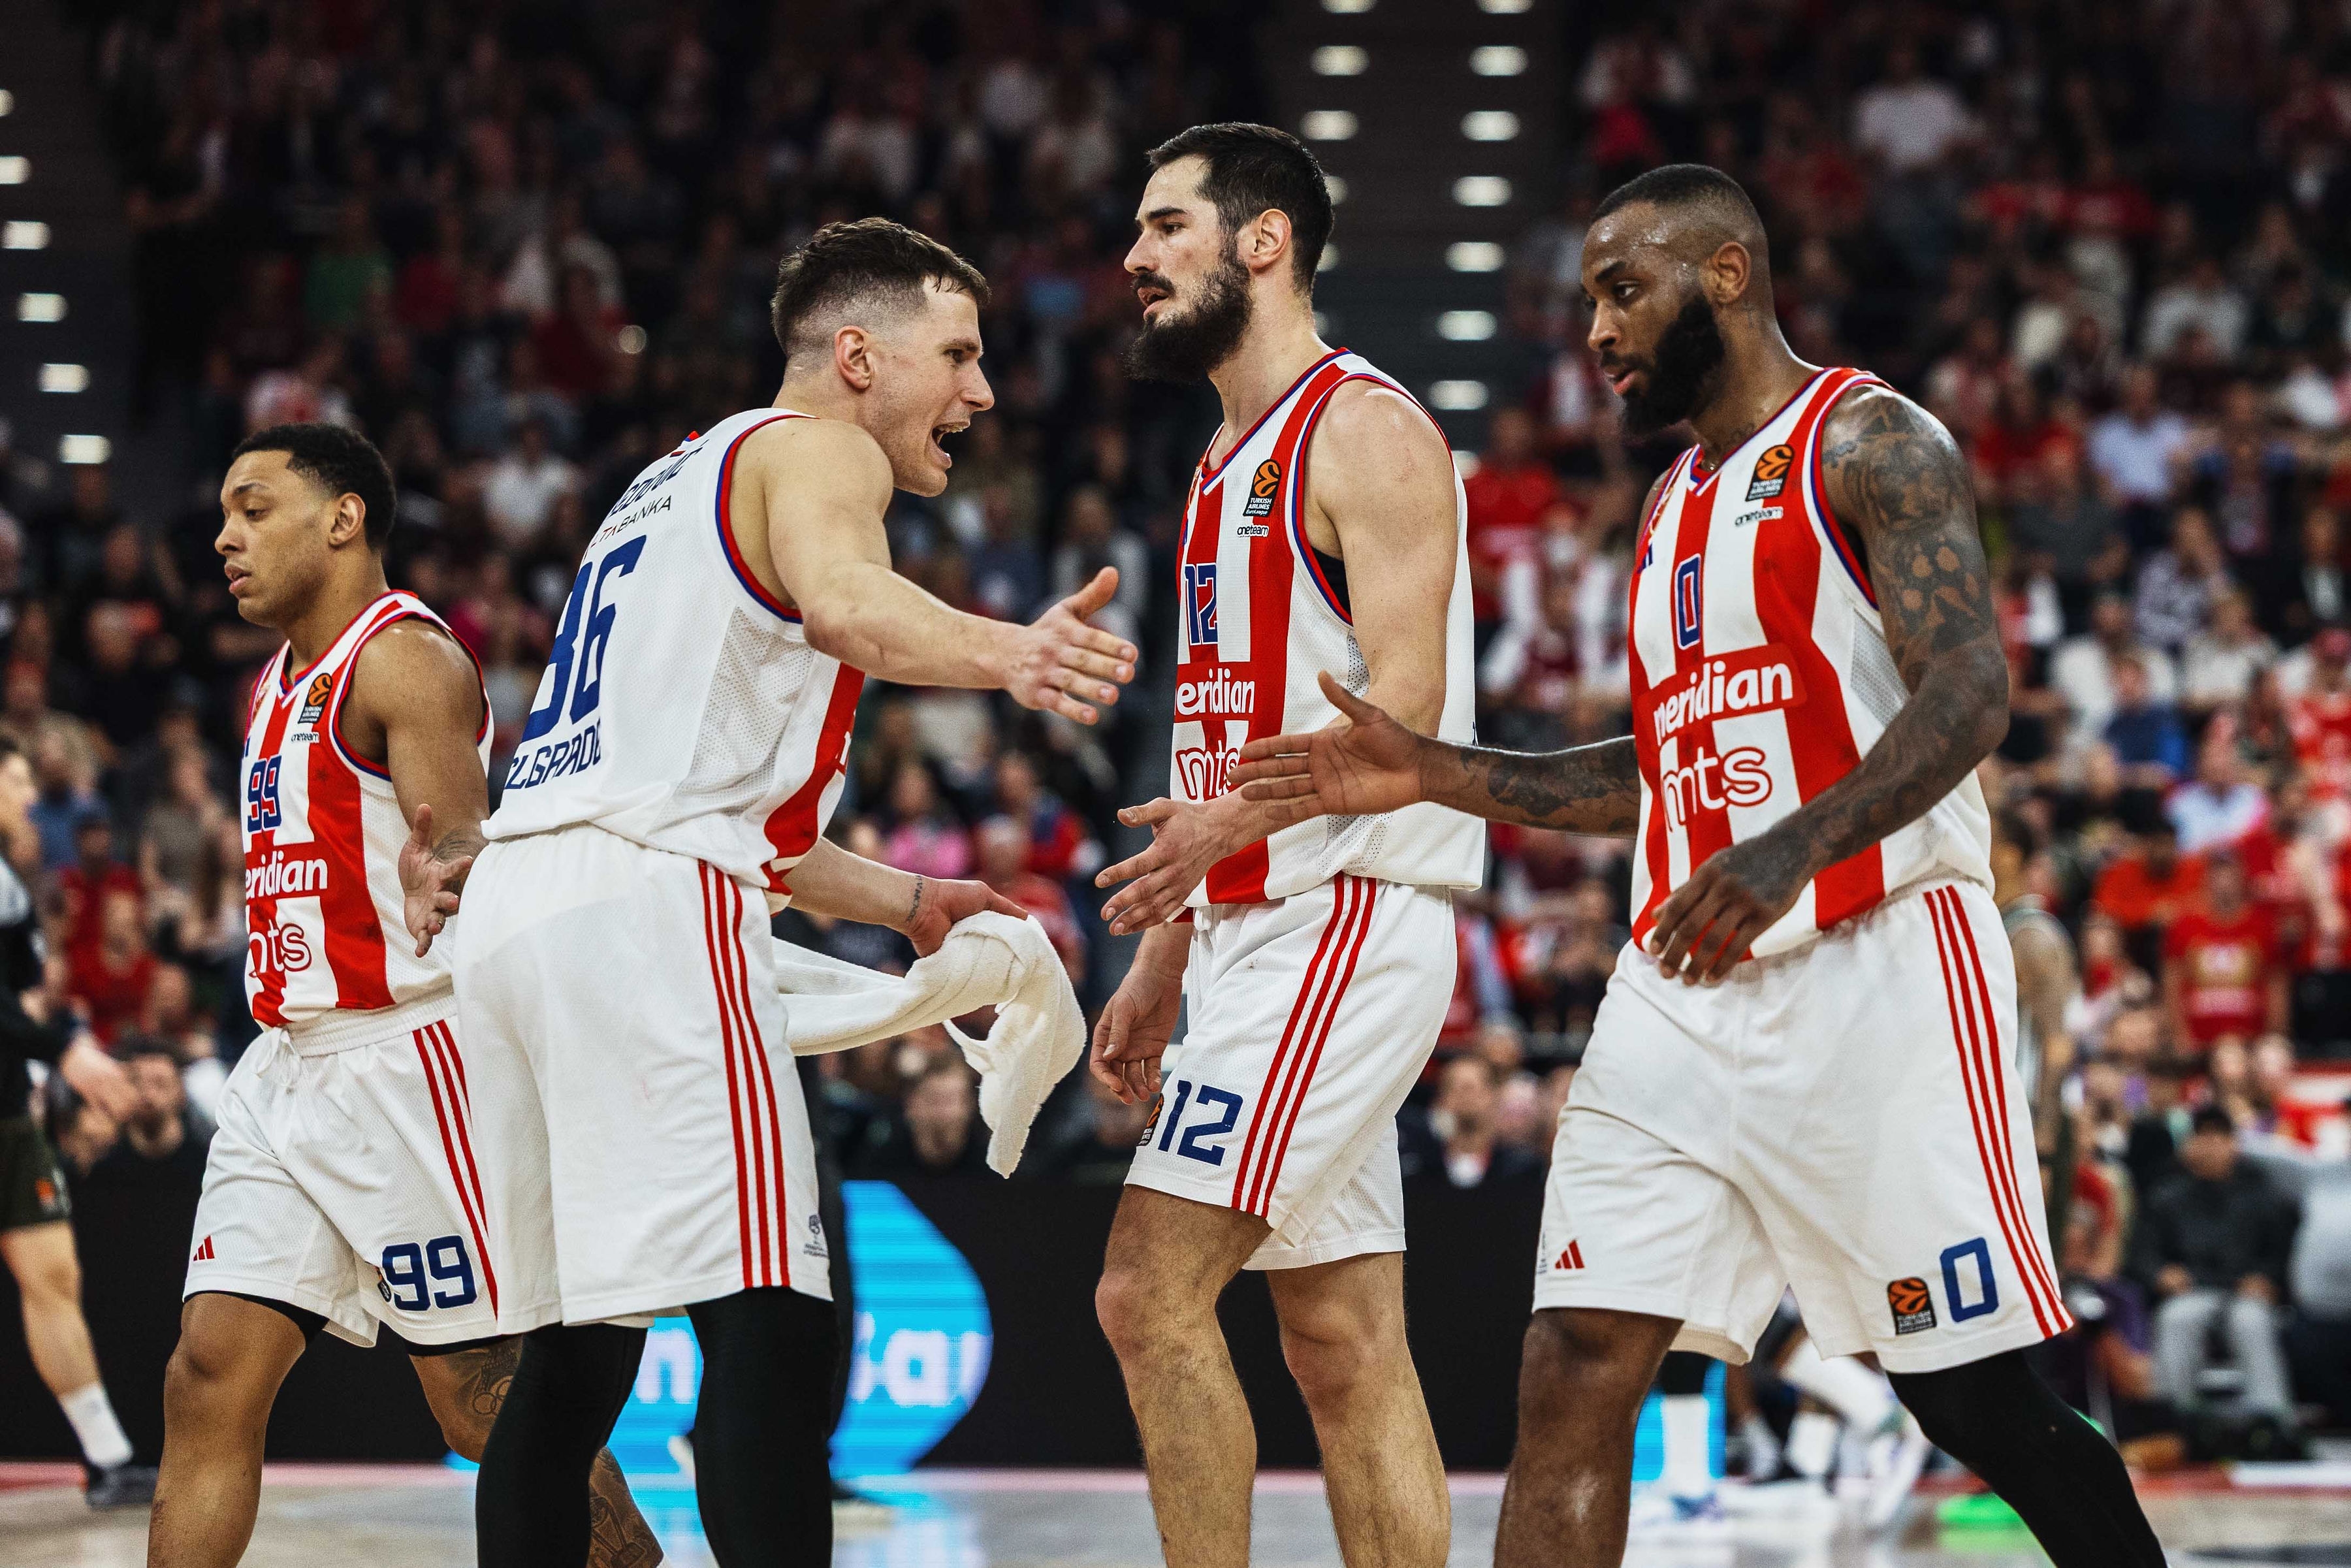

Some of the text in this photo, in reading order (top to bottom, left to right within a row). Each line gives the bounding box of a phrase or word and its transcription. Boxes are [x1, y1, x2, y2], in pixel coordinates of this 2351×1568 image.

[1237, 524, 1268, 536] oneteam
[1185, 563, 1219, 646] 12
[1674, 553, 1701, 650] 0
[1174, 667, 1255, 716] eridian
[1654, 660, 1793, 747] meridian
[248, 754, 282, 833] 99
[1663, 746, 1772, 833] mts
[246, 850, 328, 900] eridian
[1158, 1080, 1243, 1166] 12
[383, 1235, 478, 1311] 99
[1940, 1237, 1999, 1323] 0
